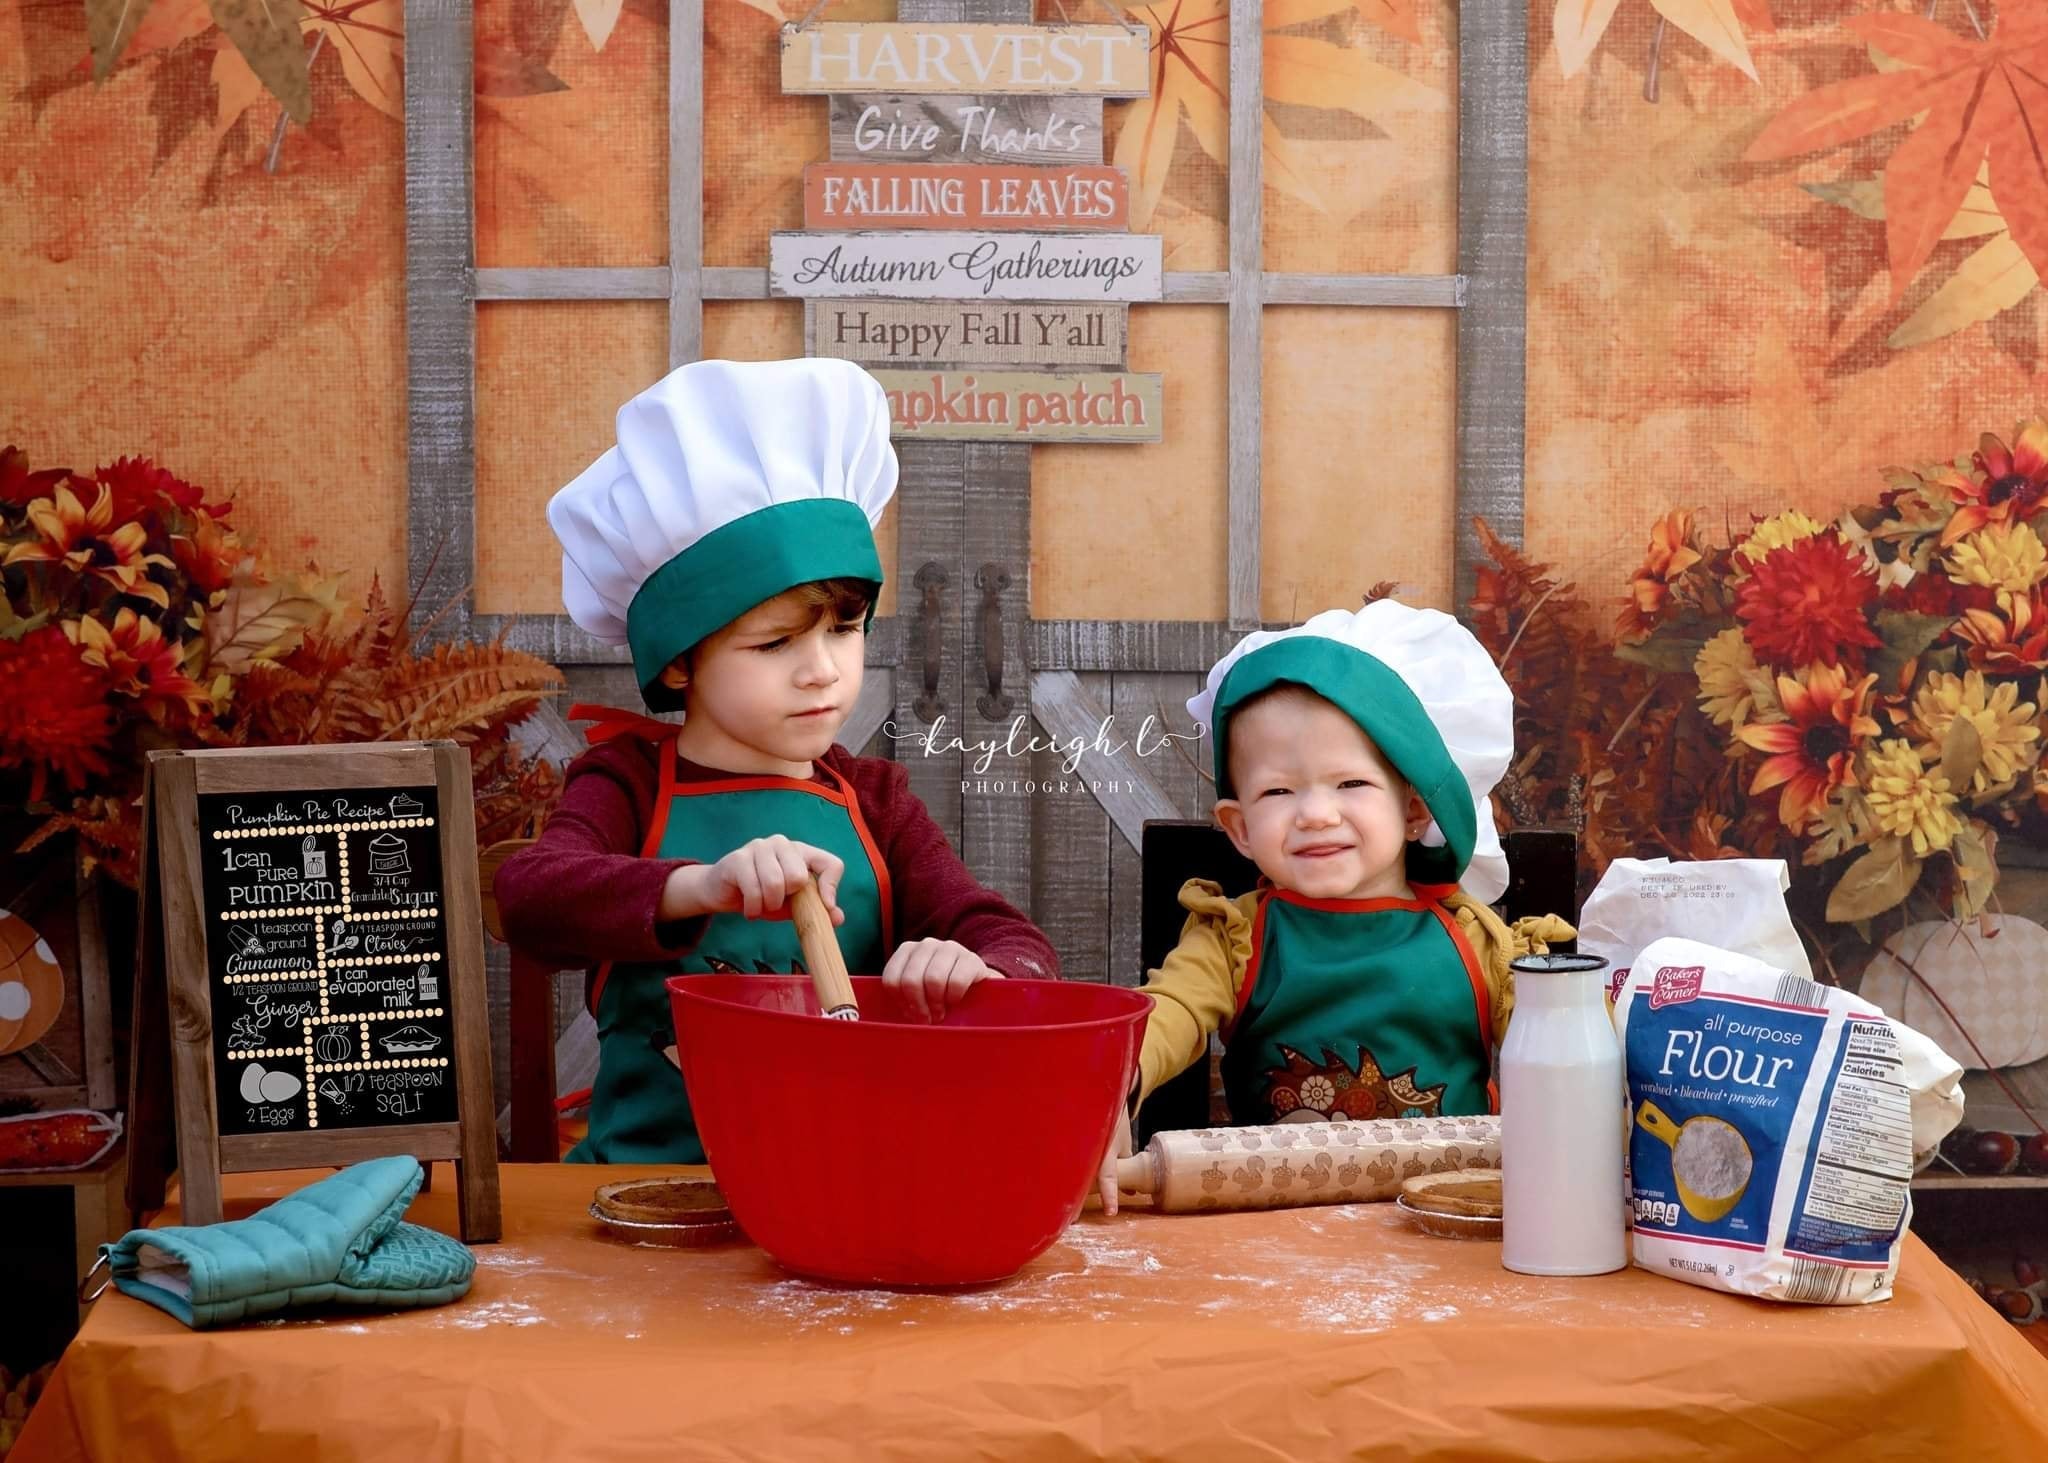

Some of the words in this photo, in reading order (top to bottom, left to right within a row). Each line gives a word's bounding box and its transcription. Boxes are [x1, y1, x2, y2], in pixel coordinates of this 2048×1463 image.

[808, 31, 1132, 86] HARVEST
[854, 105, 941, 153] Give
[956, 106, 1086, 154] Thanks
[822, 176, 968, 218] FALLING
[979, 171, 1116, 219] LEAVES
[793, 245, 945, 285] Autumn
[948, 240, 1144, 295] Gatherings
[833, 311, 952, 358] Happy
[960, 312, 1022, 346] Fall
[1032, 312, 1106, 347] Y'all
[1016, 377, 1146, 434] patch
[226, 802, 302, 828] Pumpkin
[302, 800, 331, 820] Pie
[333, 798, 386, 822] Recipe
[373, 876, 390, 886] 3/4
[392, 875, 409, 887] Cup
[351, 887, 393, 902] Granulated
[391, 888, 438, 909] Sugar
[261, 922, 313, 936] teaspoon
[367, 923, 405, 933] TEASPOON
[406, 921, 436, 931] GROUND
[266, 936, 307, 953] ground
[364, 931, 416, 954] Cloves
[226, 953, 312, 975] Cinnamon
[329, 976, 416, 997] evaporated
[335, 969, 342, 983] 1
[345, 968, 369, 980] can
[232, 984, 245, 996] 1/2
[246, 983, 286, 995] TEASPOON
[287, 981, 318, 993] GROUND
[383, 991, 414, 1008] milk
[1652, 987, 1697, 1006] Corner
[246, 994, 318, 1029] Ginger
[1704, 1013, 1725, 1032] all
[1726, 1021, 1803, 1046] purpose
[1658, 1029, 1794, 1090] Flour
[1843, 1064, 1886, 1078] Calories
[343, 1074, 365, 1093] 1/2
[1680, 1085, 1723, 1101] bleached
[1727, 1092, 1780, 1109] presifted
[246, 1109, 255, 1123] 2
[259, 1106, 295, 1126] Eggs
